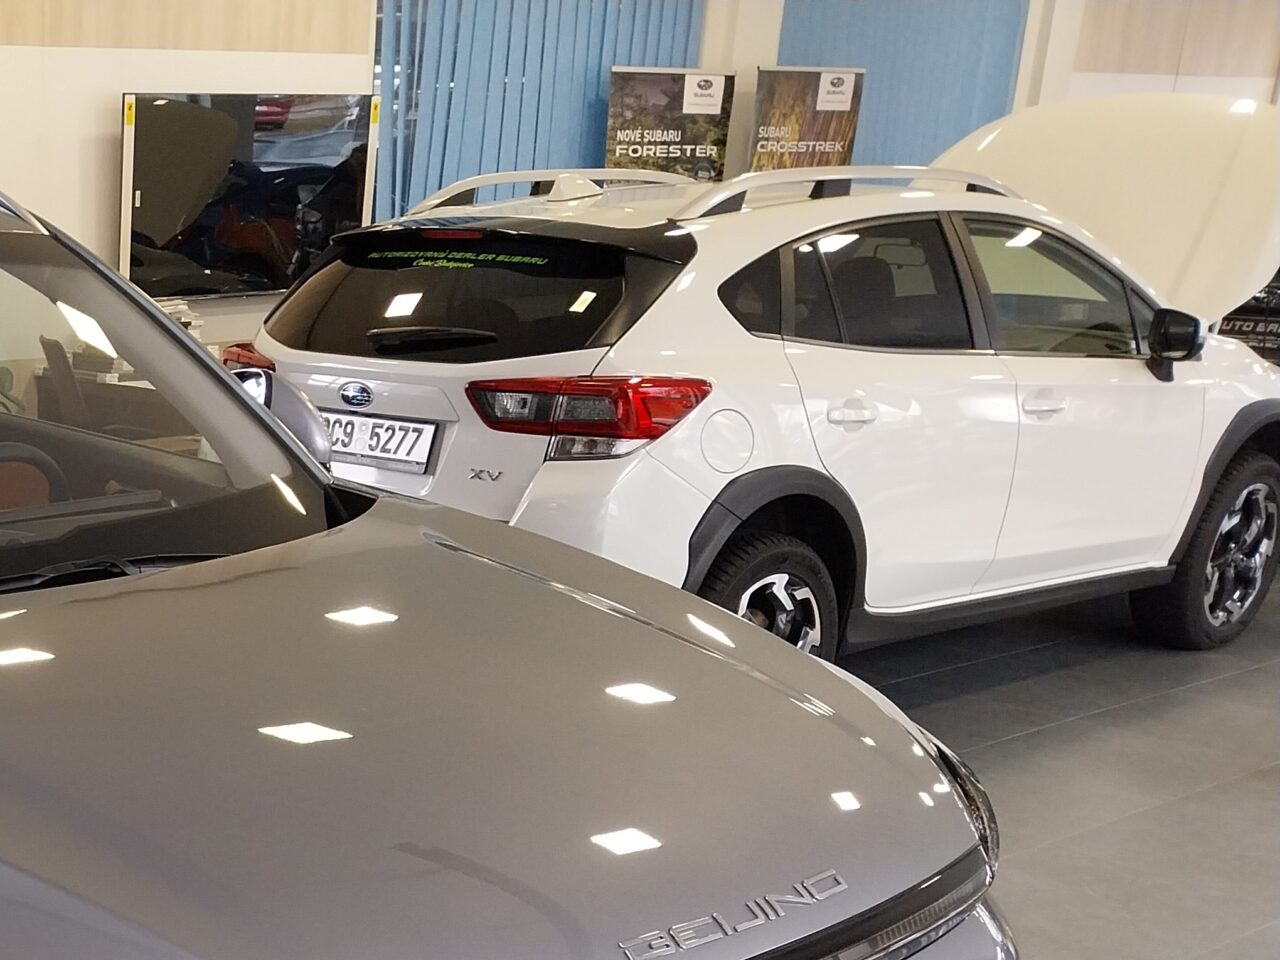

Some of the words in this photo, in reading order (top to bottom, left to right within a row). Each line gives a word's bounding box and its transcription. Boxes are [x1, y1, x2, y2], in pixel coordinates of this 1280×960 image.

[616, 126, 642, 142] NOVÉ
[643, 130, 682, 142] SUBARU
[758, 126, 792, 138] SUBARU
[615, 144, 718, 158] FORESTER
[756, 140, 845, 153] CROSSTREK
[447, 251, 496, 261] DEALER
[495, 254, 549, 265] SUBARU
[1221, 320, 1254, 331] UTO
[367, 423, 425, 457] 5277
[468, 467, 503, 482] XV
